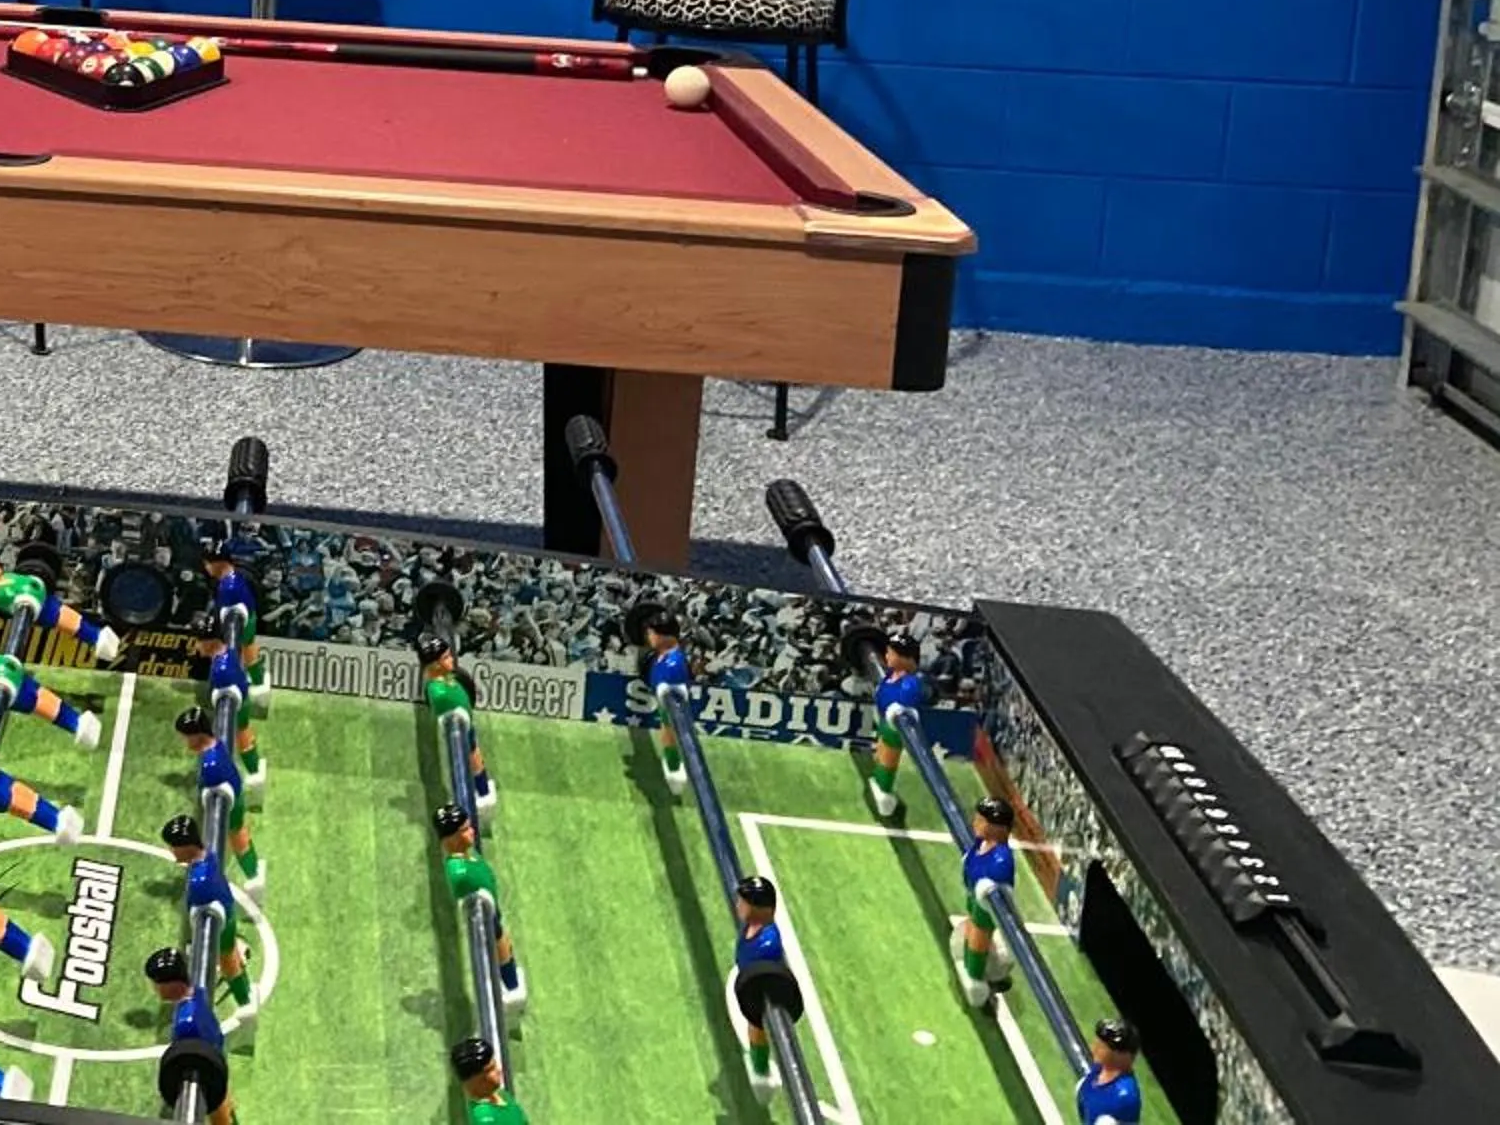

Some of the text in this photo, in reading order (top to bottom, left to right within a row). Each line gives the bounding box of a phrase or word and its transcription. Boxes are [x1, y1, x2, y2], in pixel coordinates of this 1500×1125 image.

[138, 655, 192, 679] drink
[474, 661, 579, 718] Soccer
[19, 858, 123, 1022] Foosball
